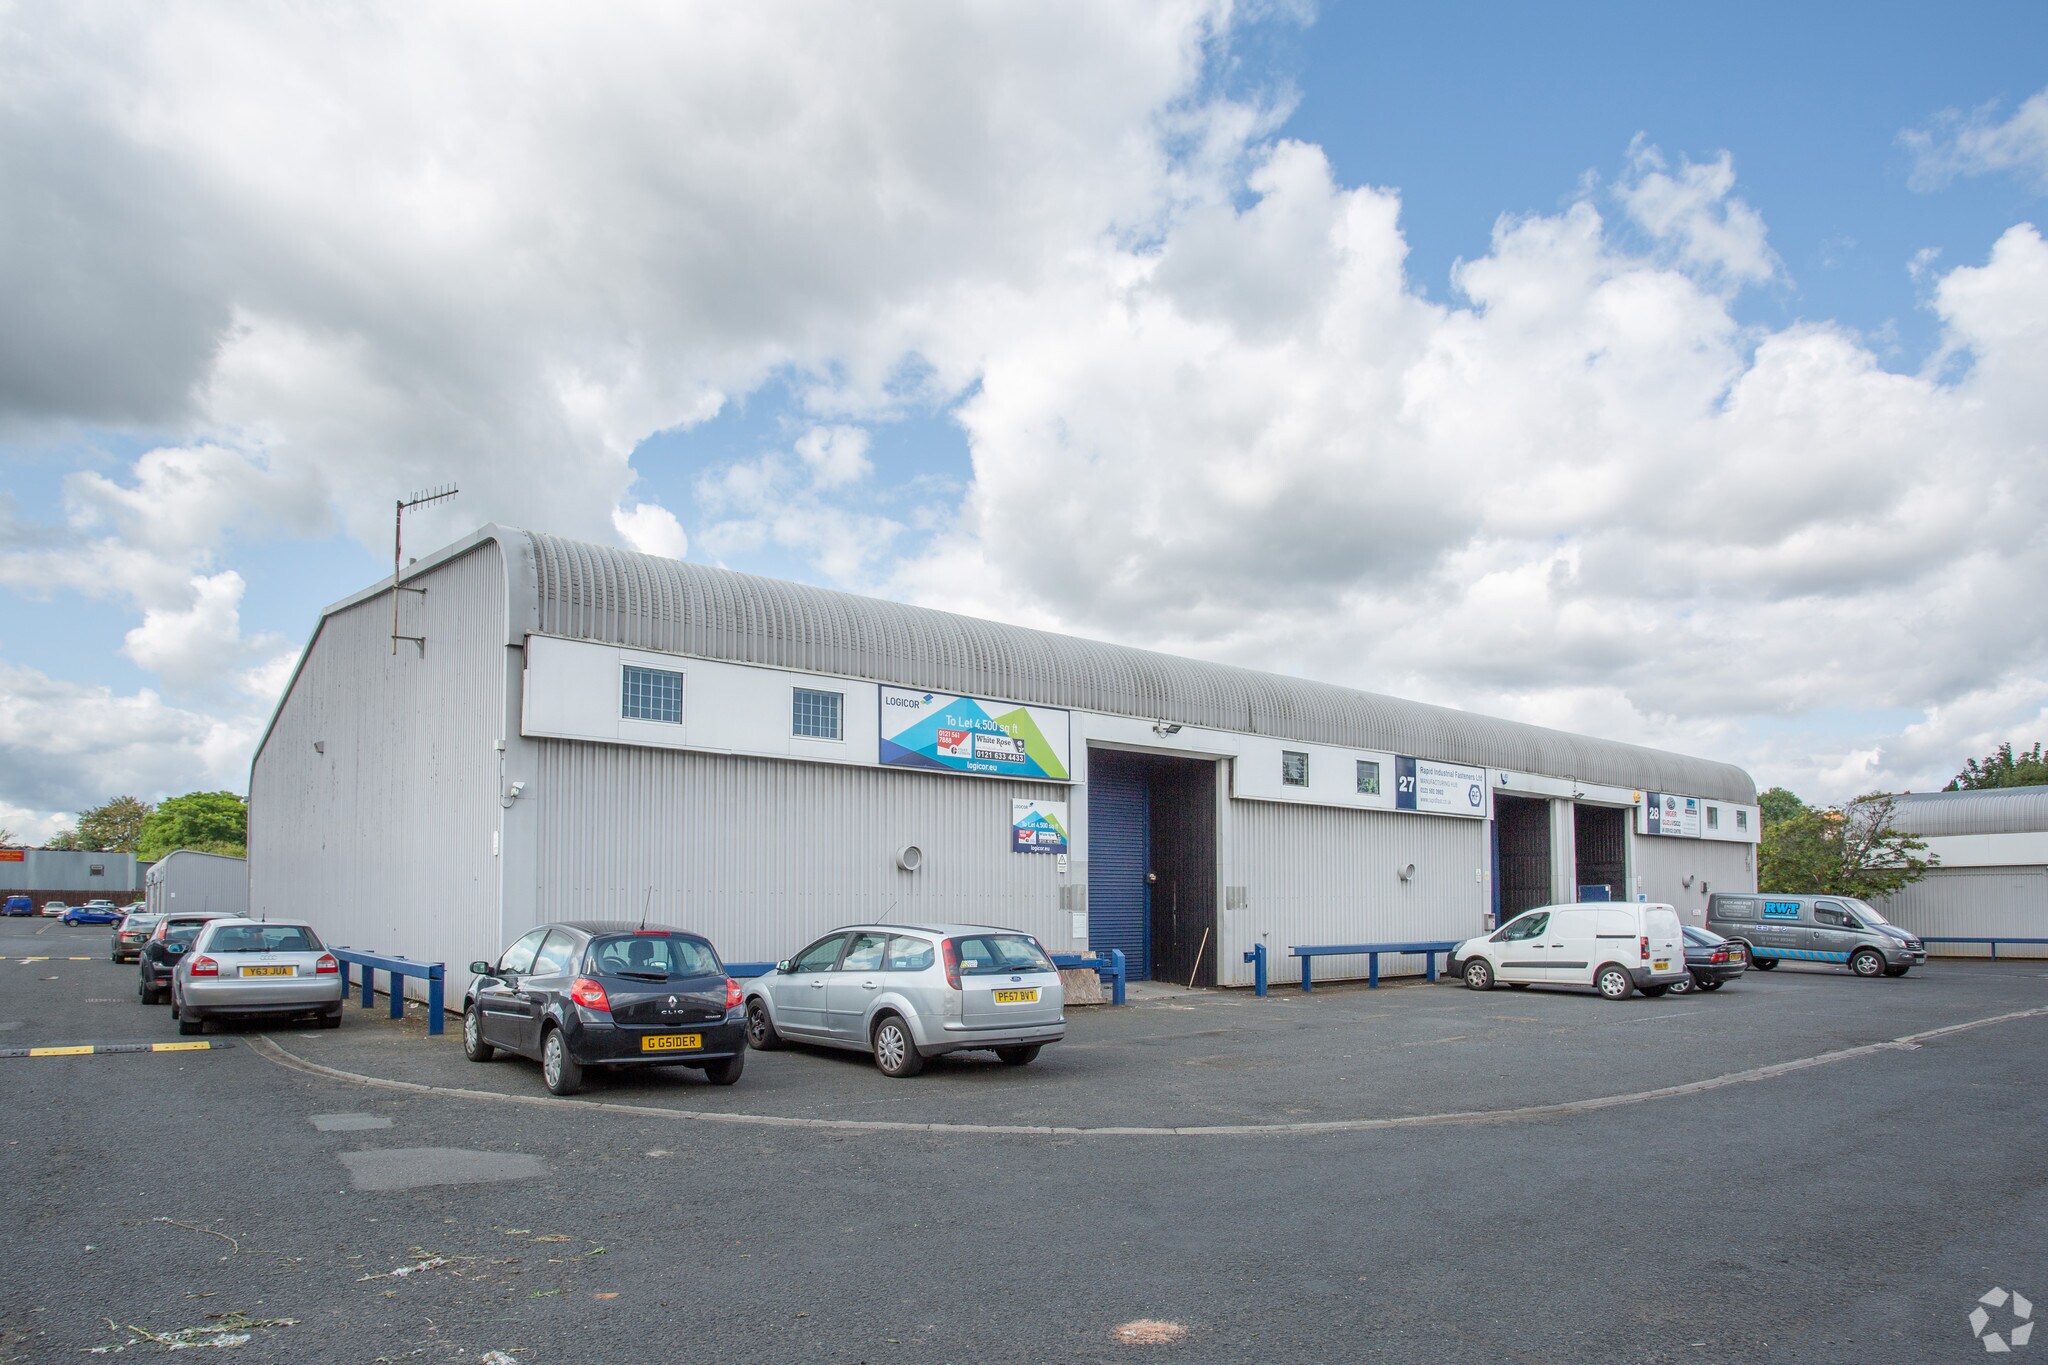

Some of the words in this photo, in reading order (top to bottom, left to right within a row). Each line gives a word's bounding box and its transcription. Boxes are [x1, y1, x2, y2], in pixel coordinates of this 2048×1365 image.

[885, 696, 920, 709] LOGICOR
[946, 714, 956, 726] To
[958, 716, 973, 728] Let
[1000, 724, 1010, 735] sq
[1012, 723, 1018, 734] ft
[938, 730, 951, 738] 0121
[976, 735, 995, 745] White
[996, 737, 1011, 748] Rose
[976, 750, 992, 759] 0121
[994, 752, 1006, 760] 633
[1007, 754, 1024, 762] 4433
[966, 761, 998, 771] logicor.eu
[1420, 766, 1433, 776] Rapid
[1434, 768, 1454, 778] Industrial
[1455, 771, 1475, 780] Fasteners
[1399, 775, 1415, 792] 27
[1649, 807, 1659, 820] 28
[1765, 902, 1799, 914] RWT
[250, 968, 268, 976] Y63
[270, 967, 288, 976] JUA
[998, 992, 1018, 1002] PF57
[1020, 991, 1034, 1000] BVT
[648, 1038, 655, 1048] G
